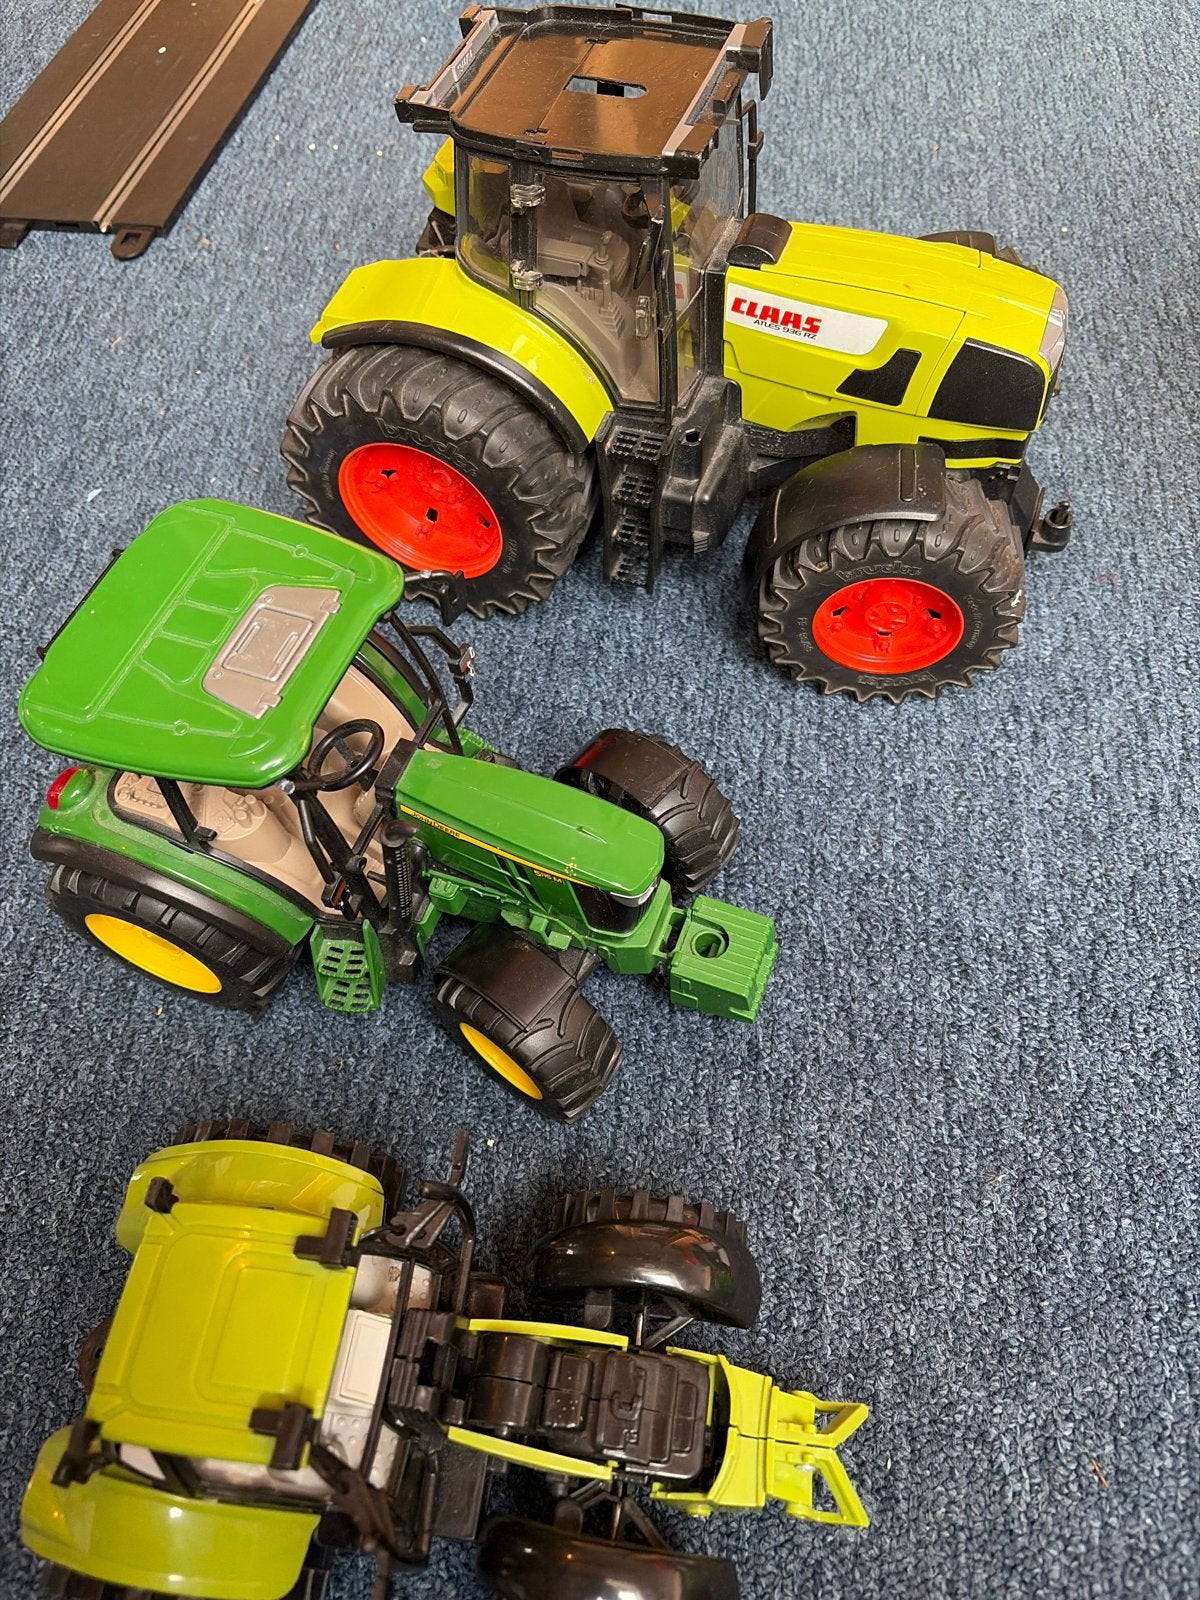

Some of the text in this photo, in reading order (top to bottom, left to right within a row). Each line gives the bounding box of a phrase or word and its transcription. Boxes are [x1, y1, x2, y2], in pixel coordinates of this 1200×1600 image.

[731, 296, 822, 334] CLAAS
[753, 319, 817, 340] ATLES 936 RZ
[413, 811, 461, 839] JOHN DEERE
